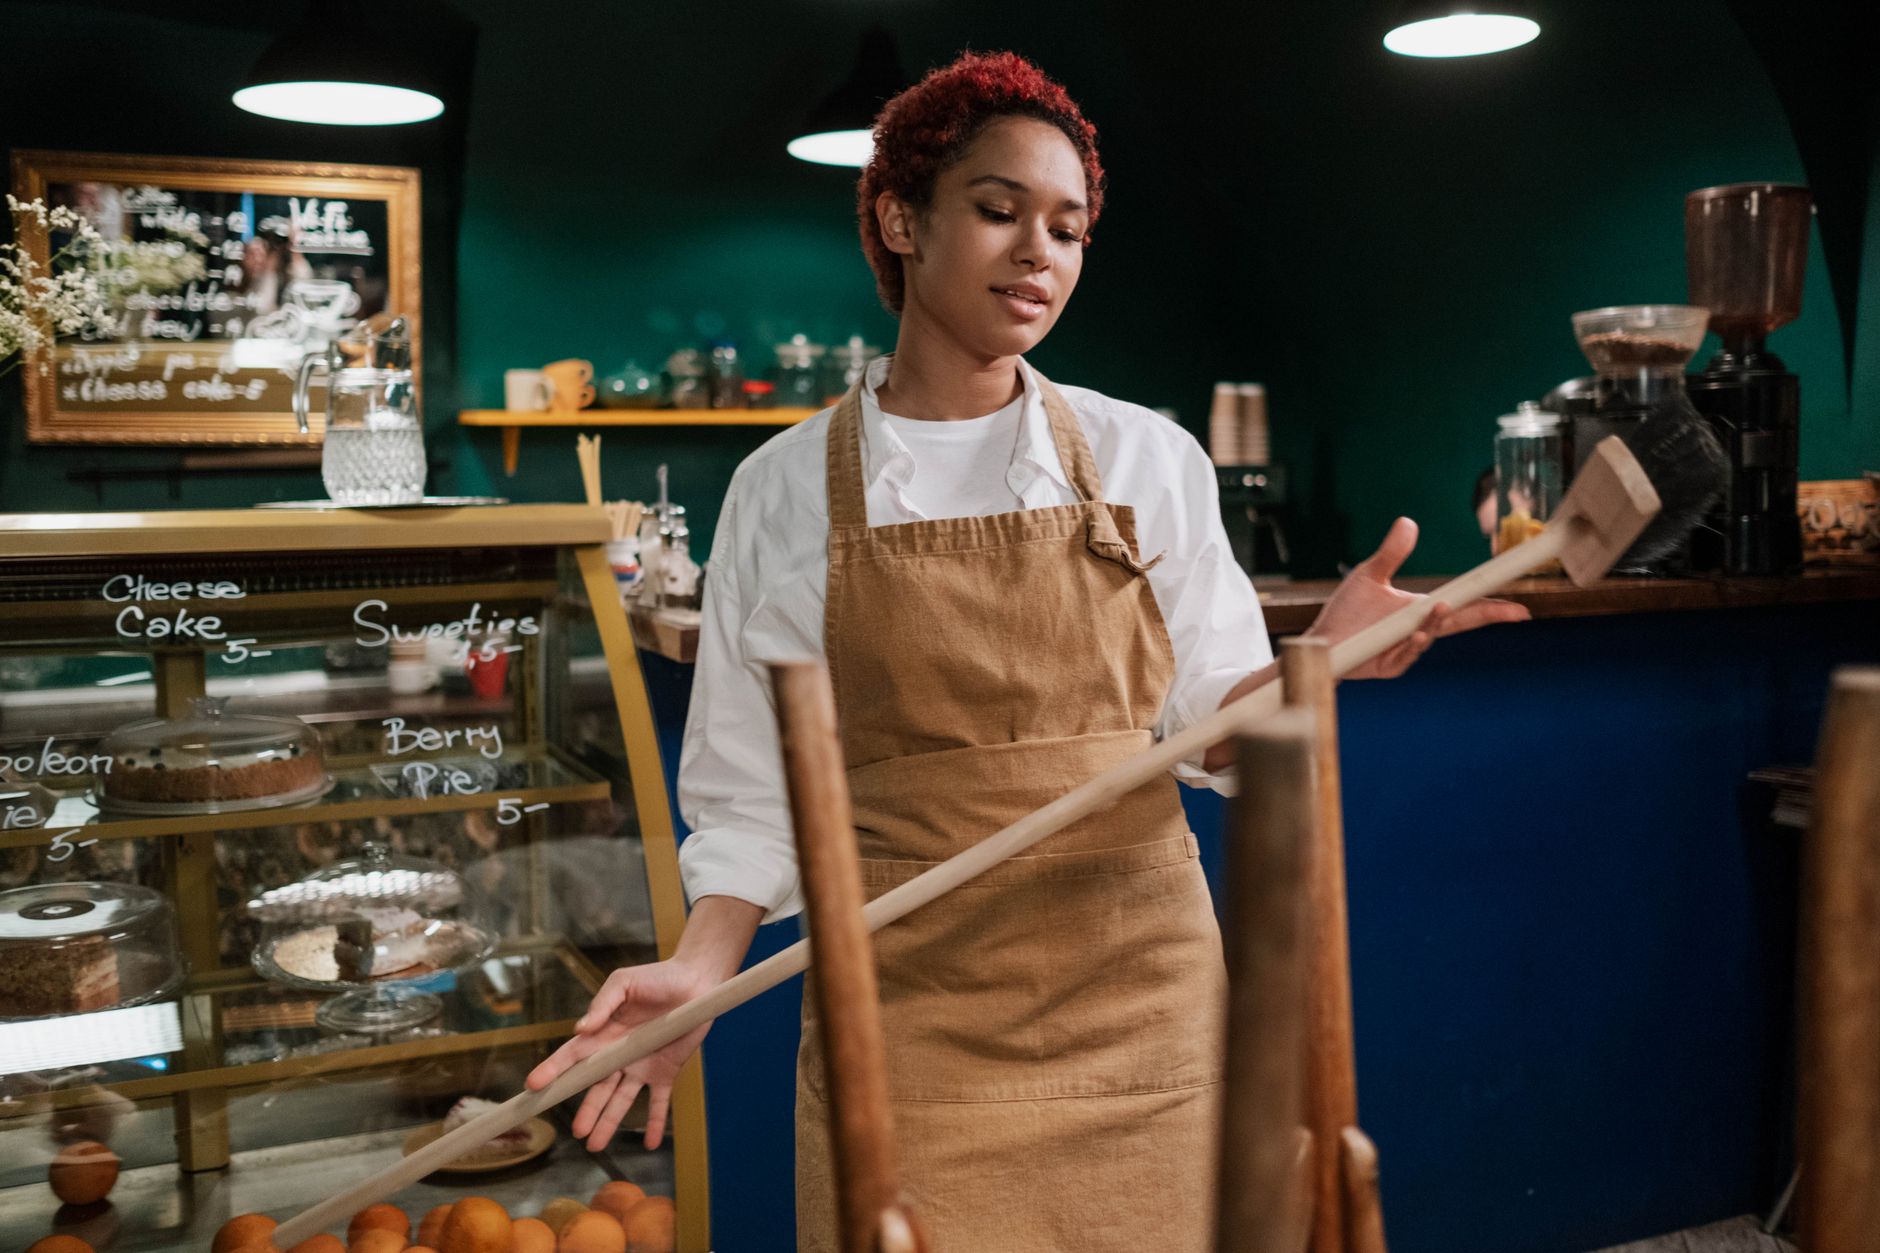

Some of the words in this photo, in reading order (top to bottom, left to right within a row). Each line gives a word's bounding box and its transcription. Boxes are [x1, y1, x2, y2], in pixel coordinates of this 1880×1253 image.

[102, 574, 247, 602] Cheese
[115, 605, 227, 639] Cake
[353, 599, 540, 647] Sweeties
[382, 717, 503, 760] Berry
[402, 762, 482, 801] Pie
